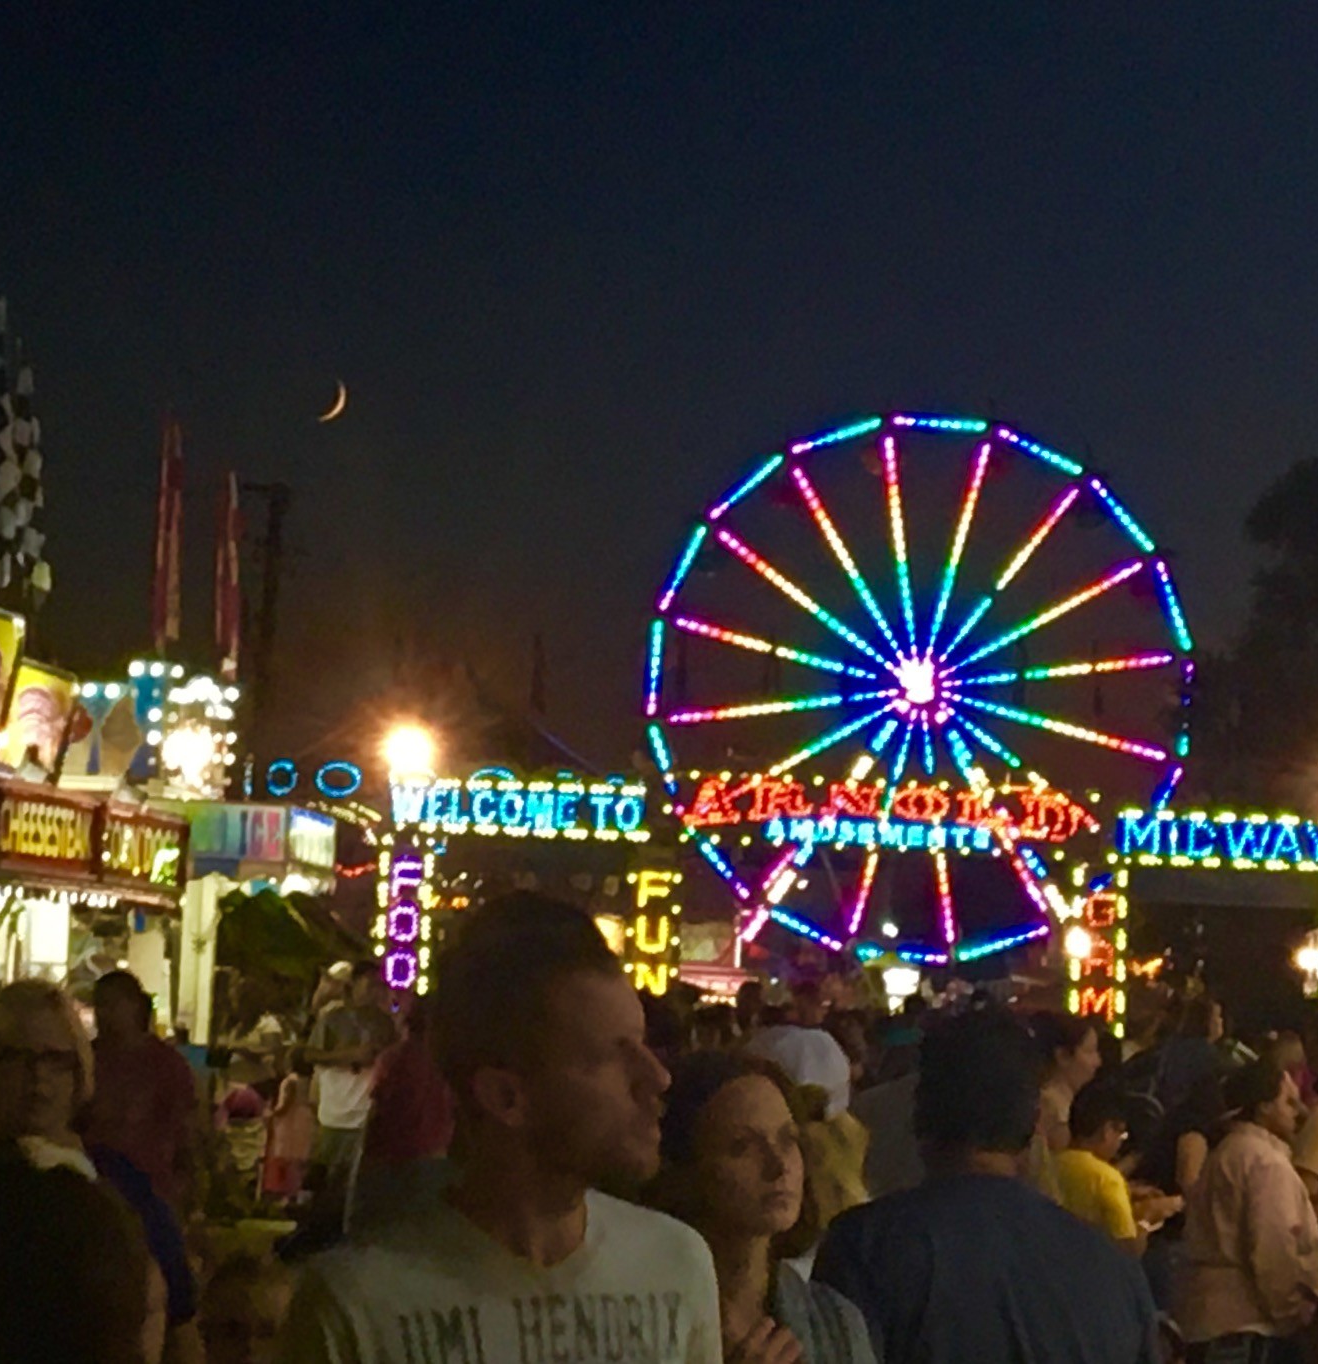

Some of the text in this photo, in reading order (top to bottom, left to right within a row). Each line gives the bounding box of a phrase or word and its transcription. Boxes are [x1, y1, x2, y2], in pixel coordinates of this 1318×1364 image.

[390, 784, 645, 831] WELCOME TO
[683, 775, 1095, 843] ARNOLD
[764, 817, 992, 850] AMUSEMENTS
[385, 858, 424, 992] FOO
[635, 870, 671, 996] FUN
[511, 1292, 682, 1362] HENDRIX
